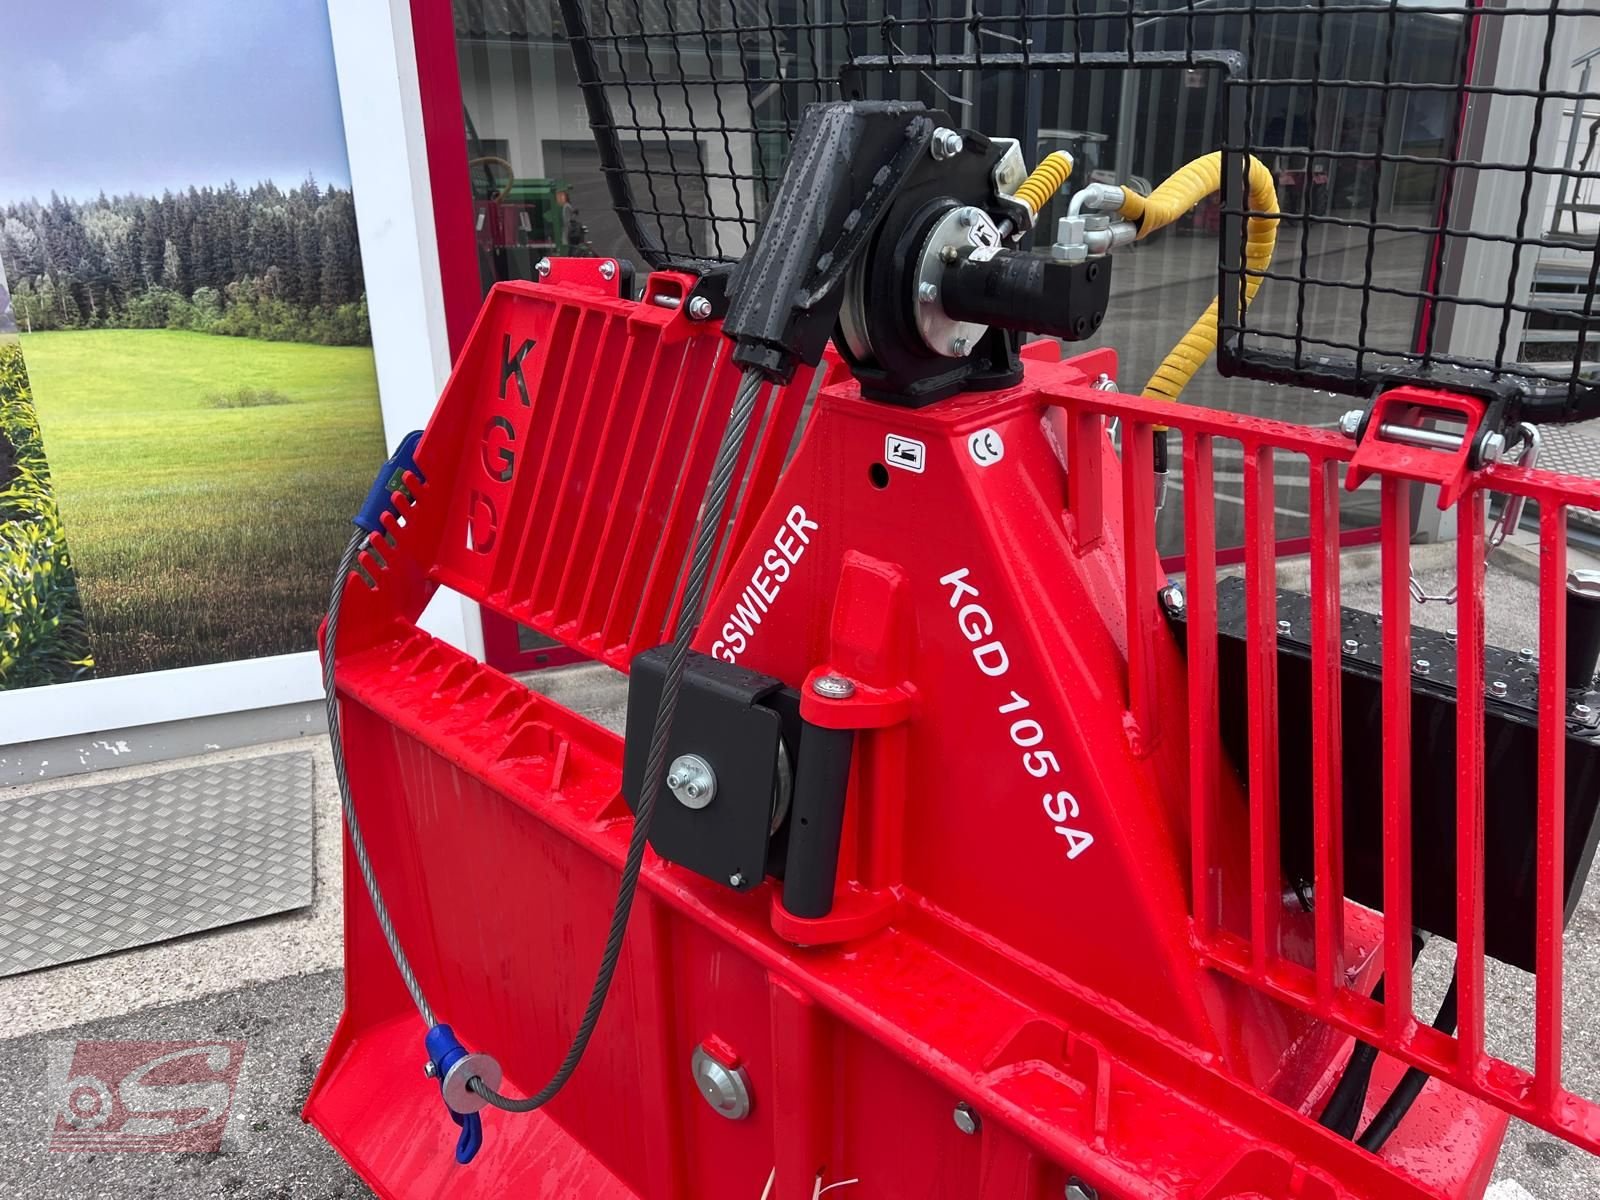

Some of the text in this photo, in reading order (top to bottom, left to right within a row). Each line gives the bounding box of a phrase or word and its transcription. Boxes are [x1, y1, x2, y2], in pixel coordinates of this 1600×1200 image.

[466, 333, 537, 554] KGD
[939, 567, 1094, 860] KGD 105 SA
